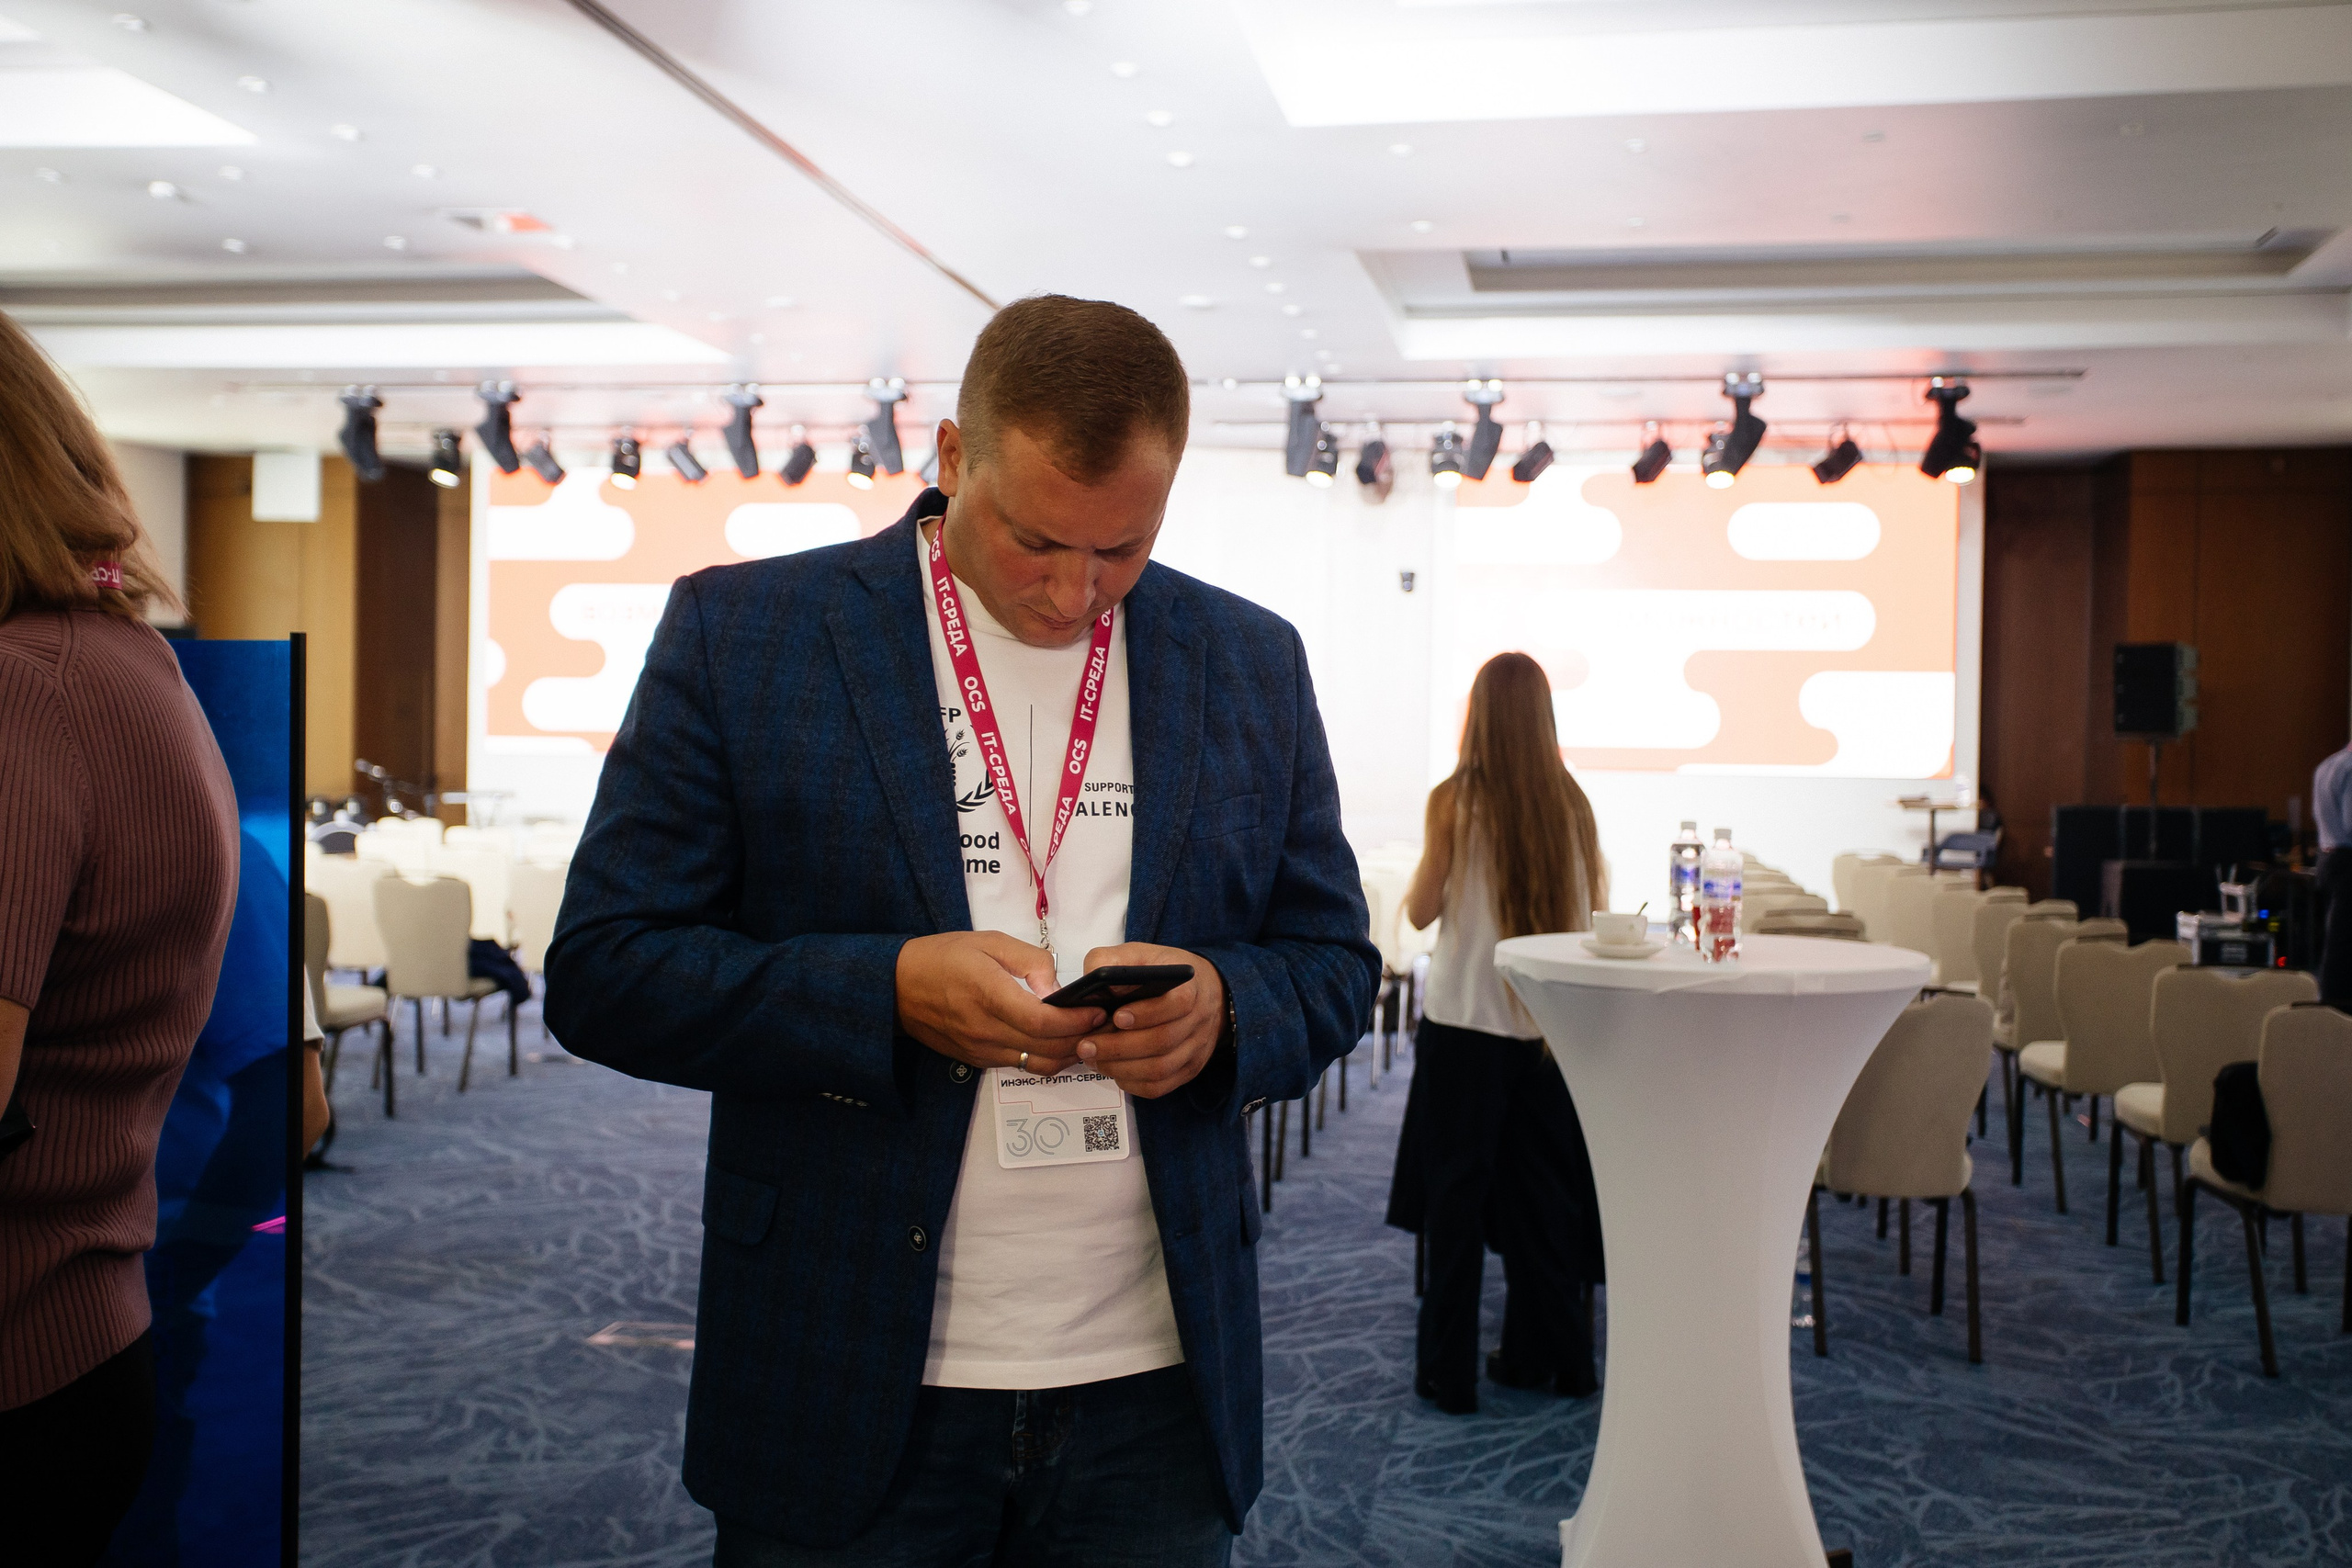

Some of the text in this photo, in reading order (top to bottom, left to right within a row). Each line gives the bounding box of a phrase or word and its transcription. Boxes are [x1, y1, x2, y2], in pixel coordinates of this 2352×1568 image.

[937, 577, 967, 657] IT-СРЕДА
[965, 676, 986, 713] OCS
[981, 731, 1017, 816] IT-СРЕДА
[1047, 646, 1106, 865] -СРЕДА OCS IT-СРЕДА
[1075, 801, 1134, 818] ALEN
[960, 831, 1000, 850] ood
[1006, 1116, 1070, 1157] 30
